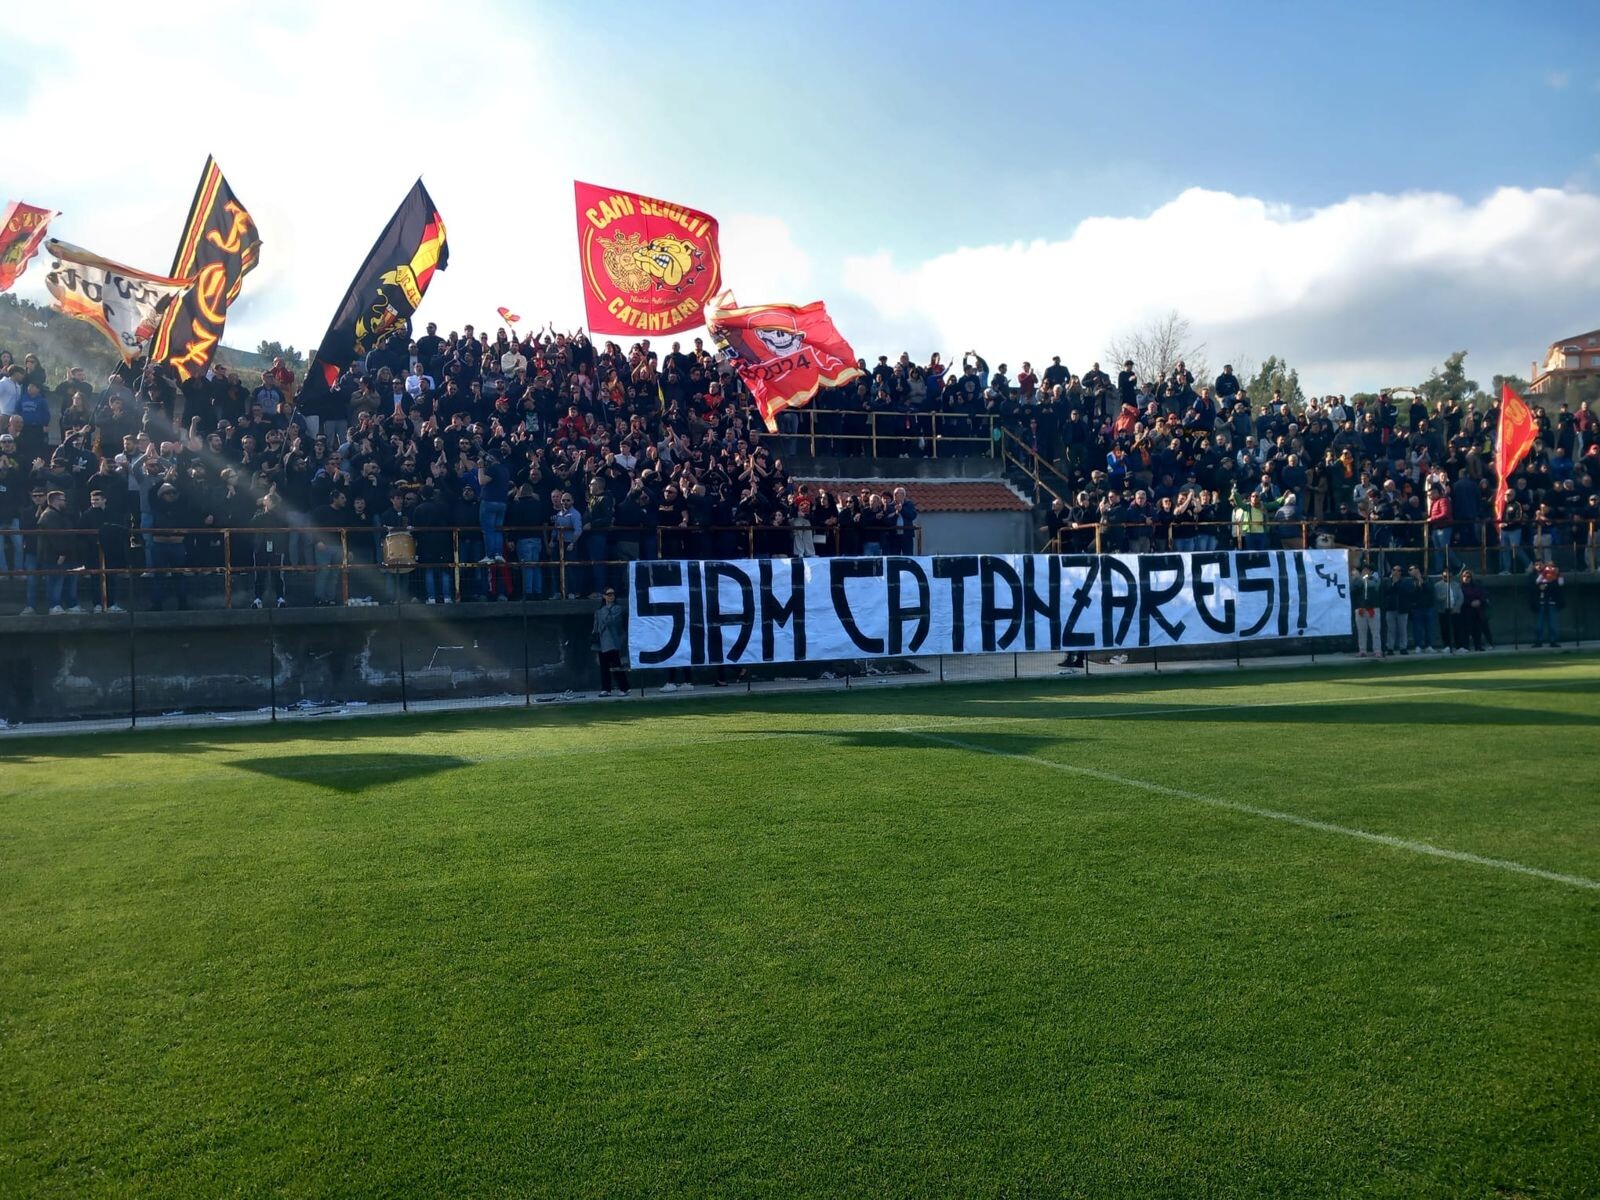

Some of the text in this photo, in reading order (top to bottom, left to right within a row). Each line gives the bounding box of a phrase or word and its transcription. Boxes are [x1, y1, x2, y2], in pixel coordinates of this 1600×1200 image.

[585, 194, 711, 238] CANI SCIOLTI
[607, 296, 700, 331] CATANZARO
[634, 550, 1308, 665] SIAM CATANZARESI!
